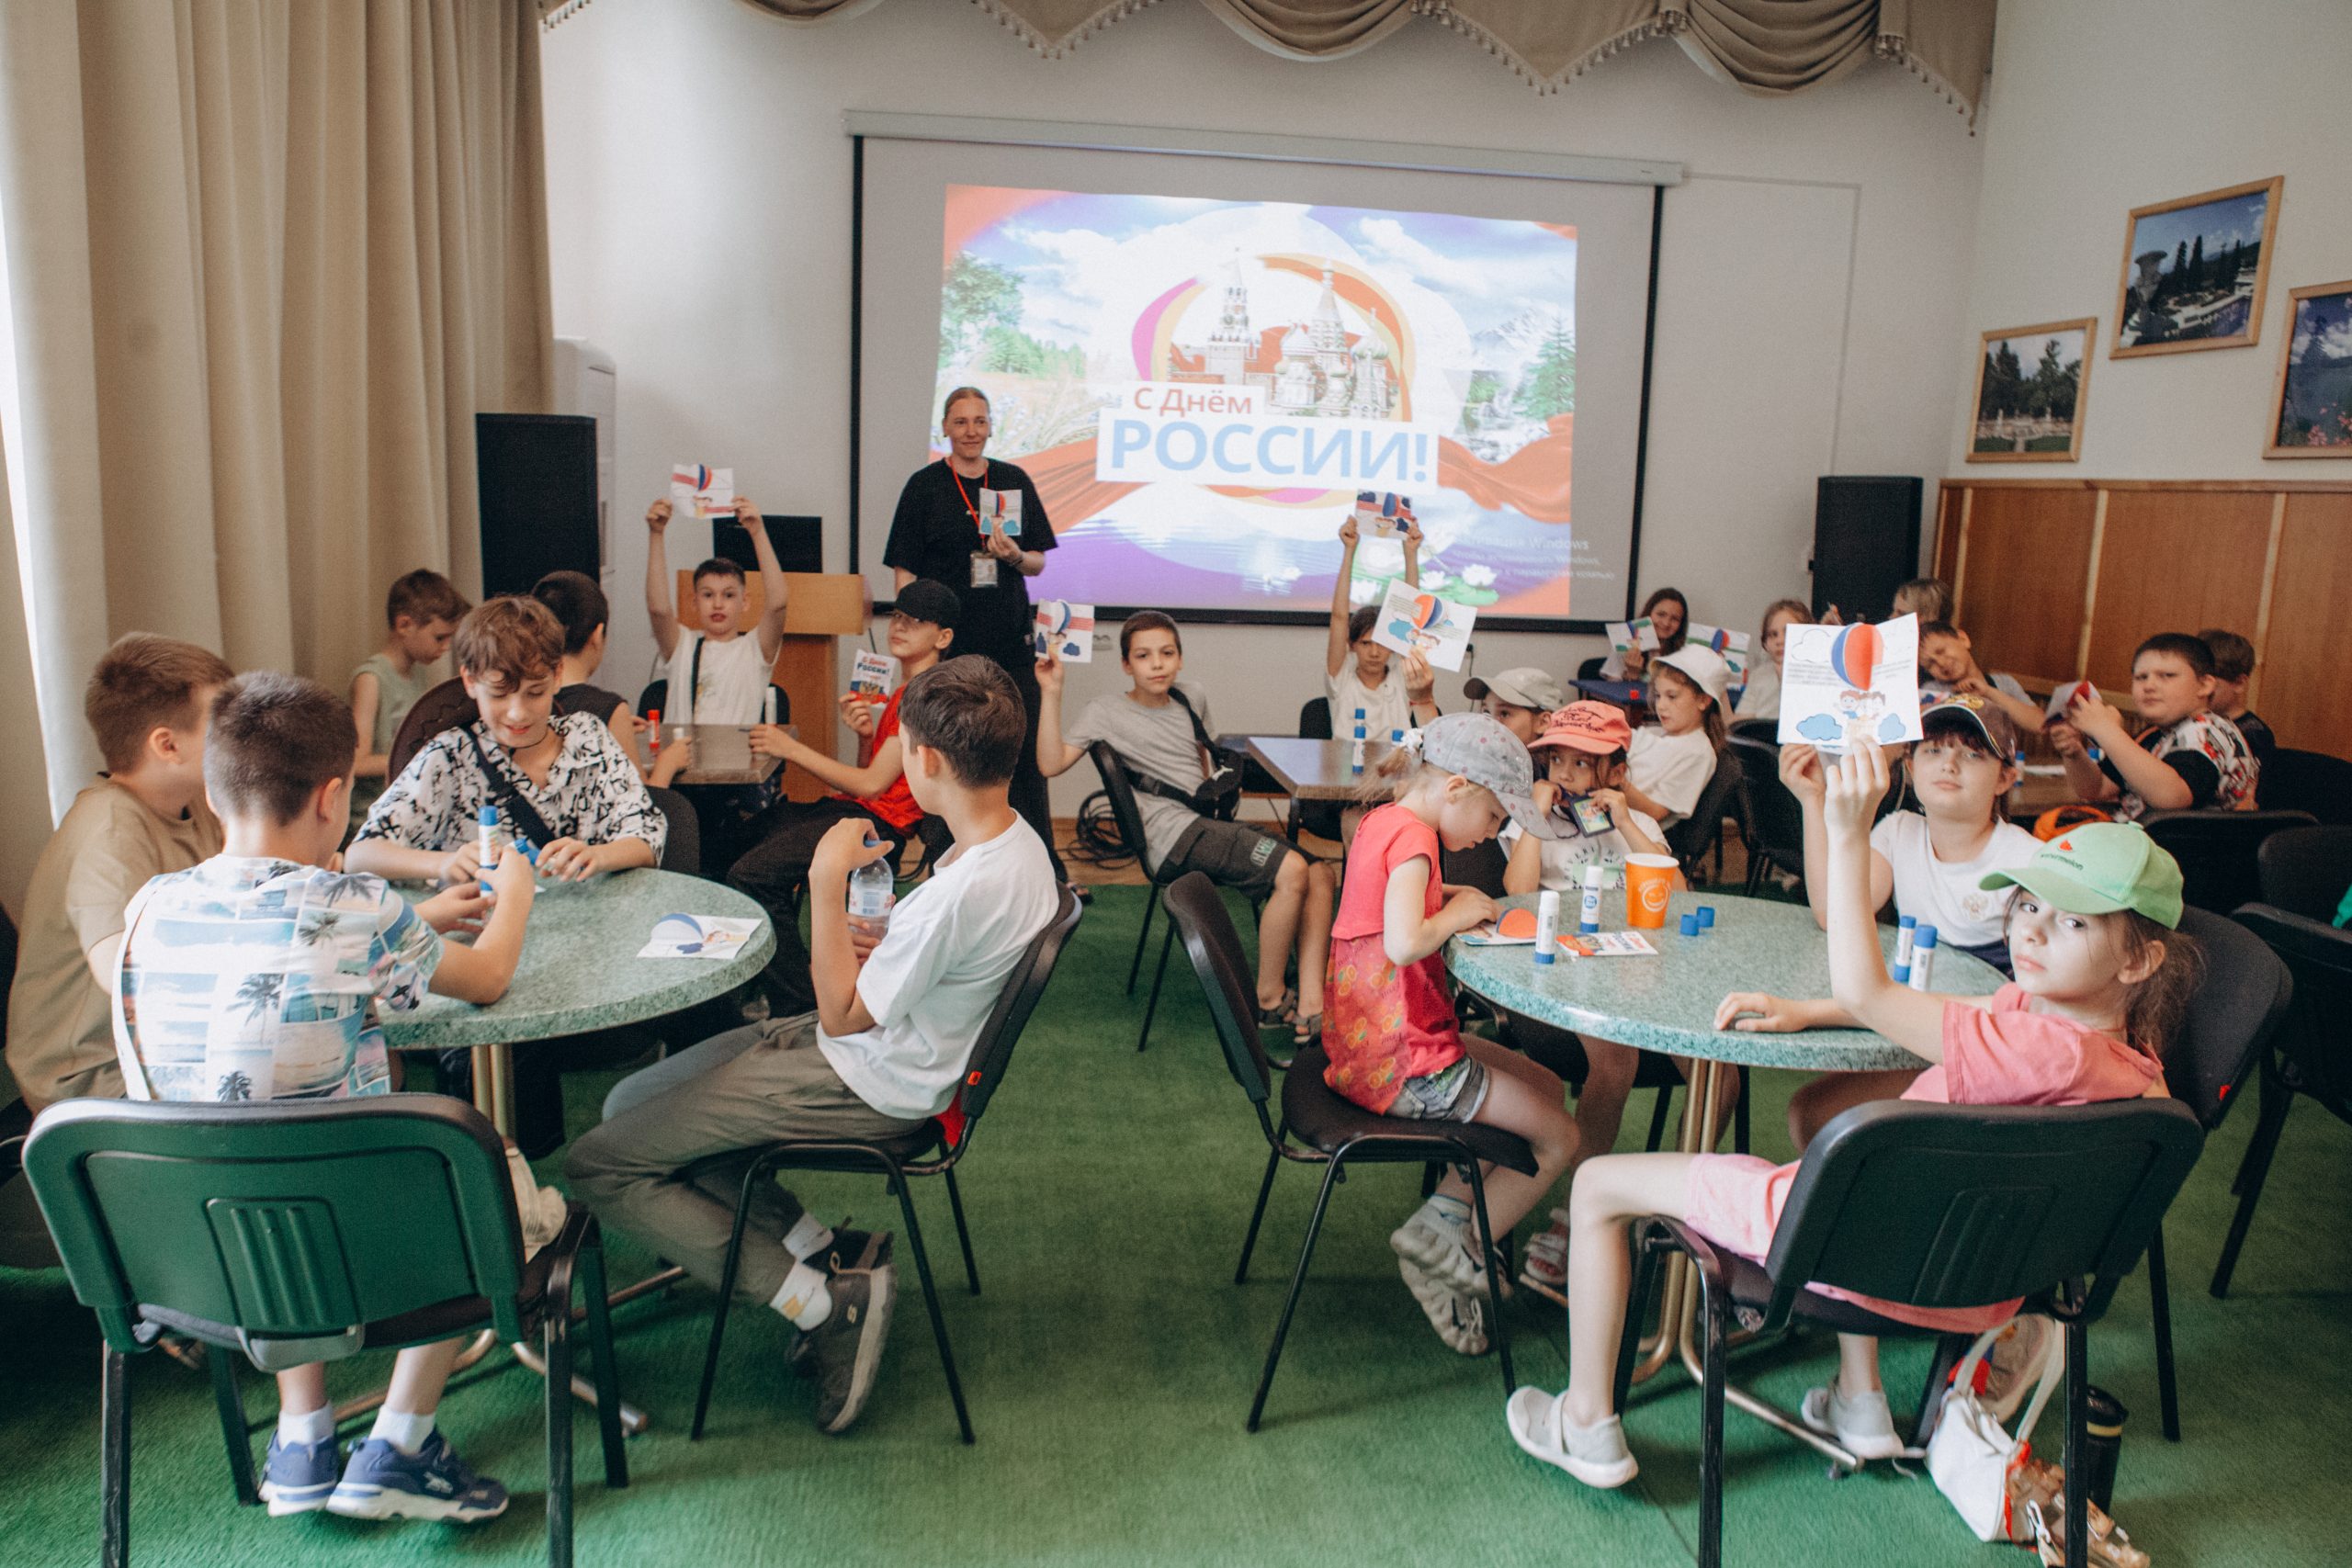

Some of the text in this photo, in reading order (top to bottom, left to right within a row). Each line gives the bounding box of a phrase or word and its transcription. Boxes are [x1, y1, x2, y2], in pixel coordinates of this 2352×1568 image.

[1134, 387, 1251, 417] С Днём
[1111, 419, 1428, 482] РОССИИ!
[1528, 536, 1589, 550] Windows
